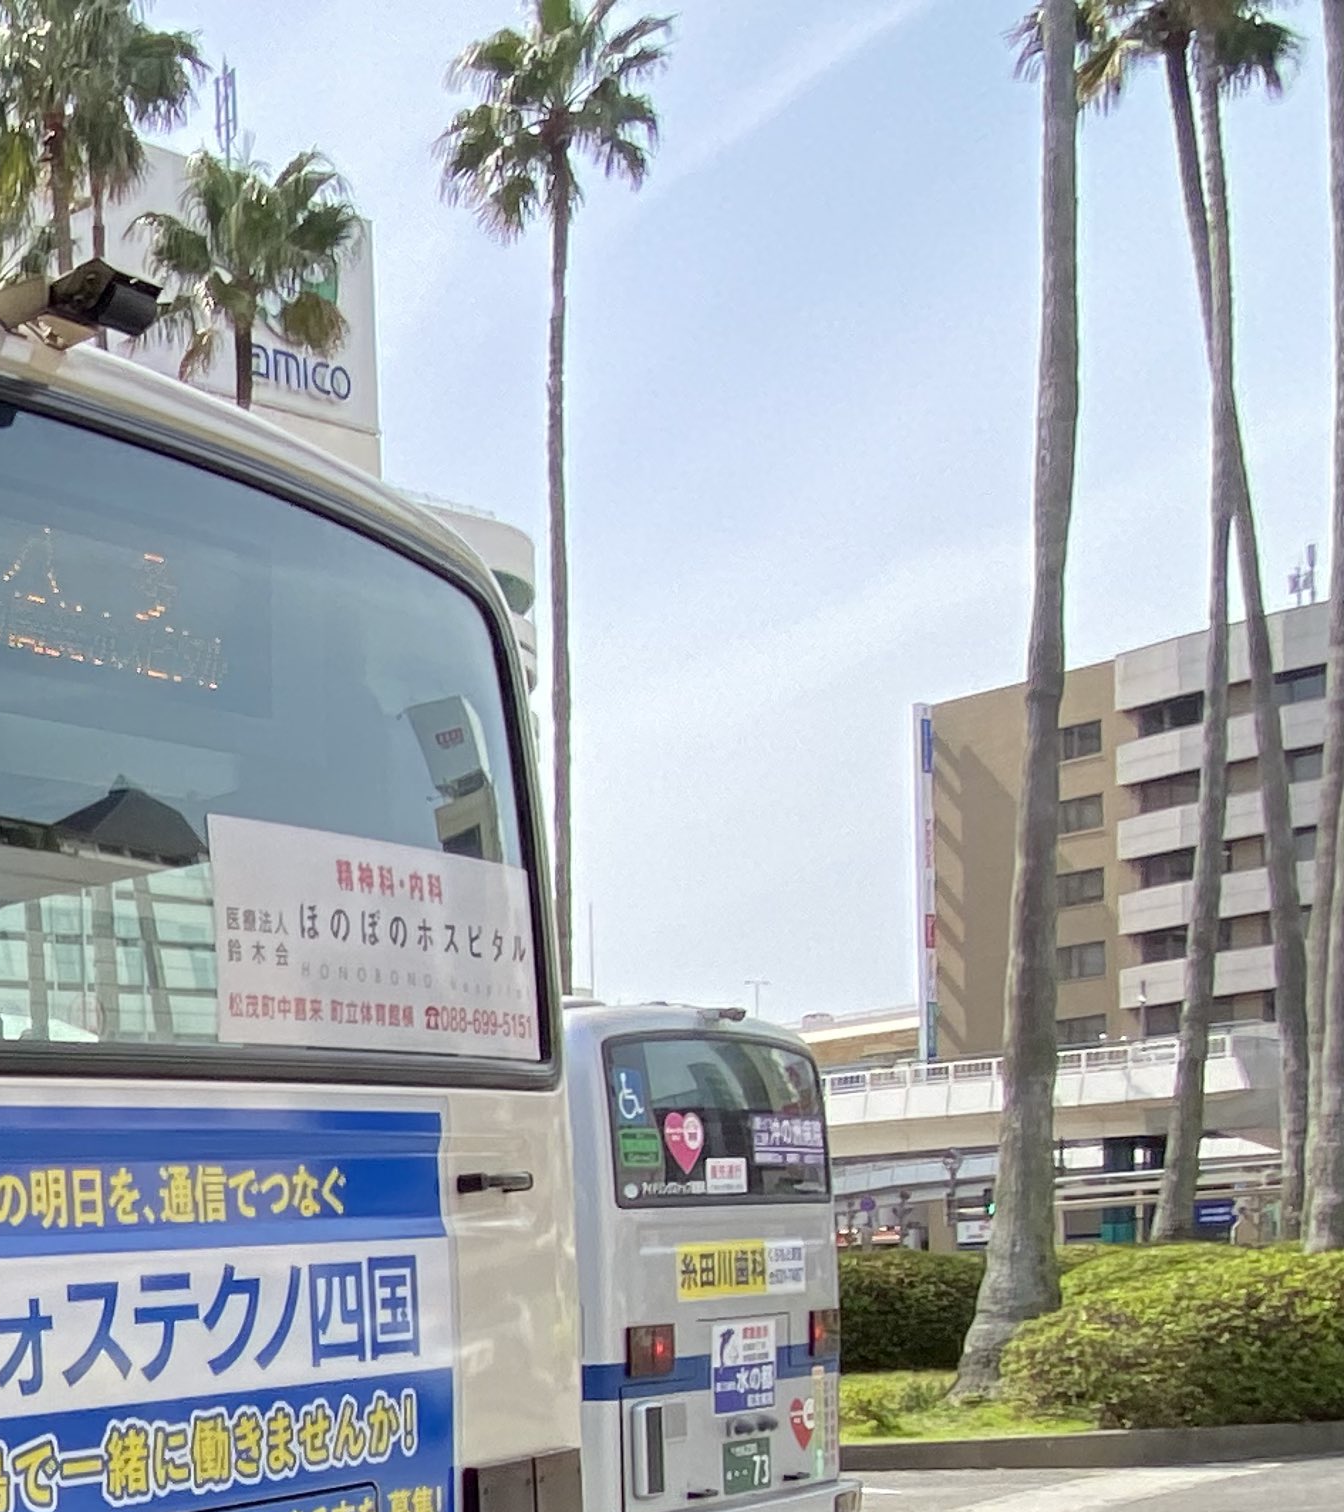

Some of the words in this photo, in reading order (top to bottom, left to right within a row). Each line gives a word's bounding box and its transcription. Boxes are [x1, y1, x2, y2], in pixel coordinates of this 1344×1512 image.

[251, 343, 351, 401] amico
[335, 858, 444, 905] 精神科・内科
[226, 906, 290, 937] 医療法人
[299, 903, 527, 961] ほのぼのホスピタル
[227, 938, 290, 967] 鈴木会
[440, 1006, 532, 1040] 088-699-5151
